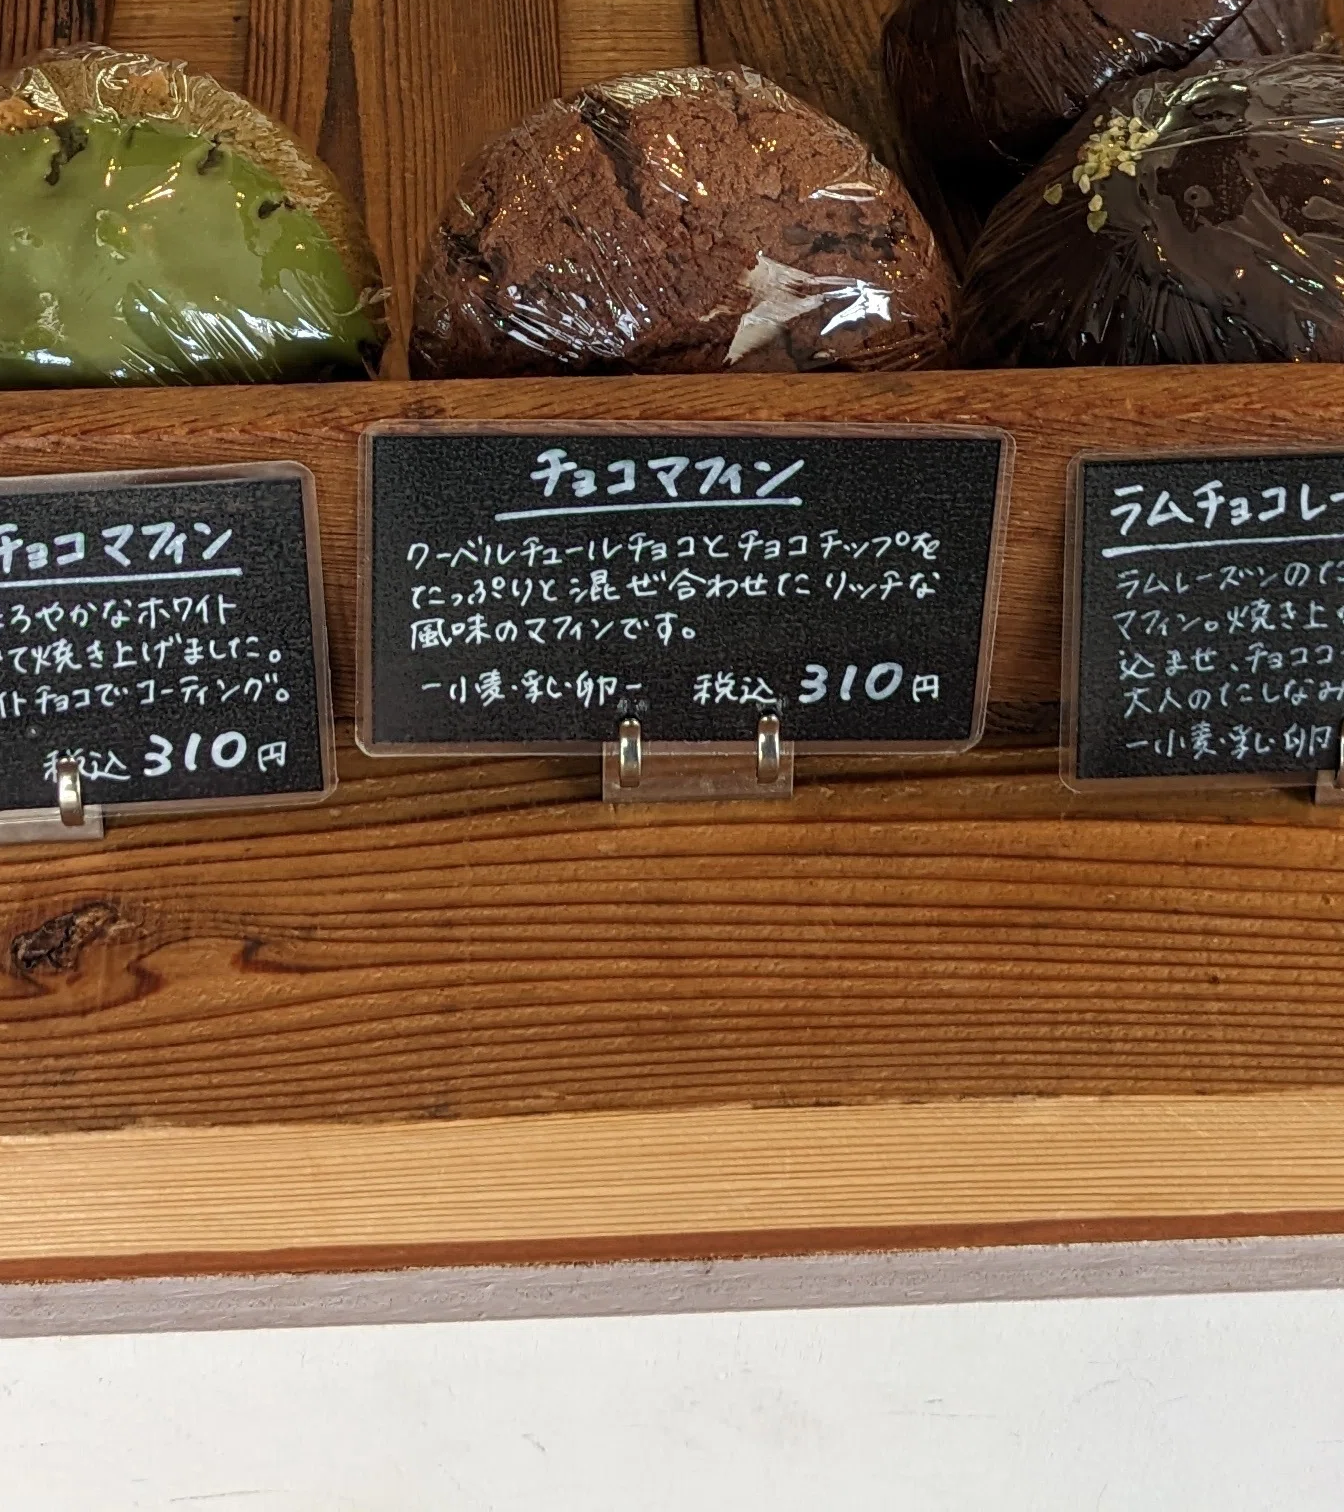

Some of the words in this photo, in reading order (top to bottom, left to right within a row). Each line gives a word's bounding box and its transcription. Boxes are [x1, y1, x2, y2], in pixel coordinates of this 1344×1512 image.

[530, 448, 805, 499] チョコマフィン
[407, 531, 940, 569] クーベルチュールチョコとチョコチップを
[410, 612, 696, 651] 風味のマフィンです。
